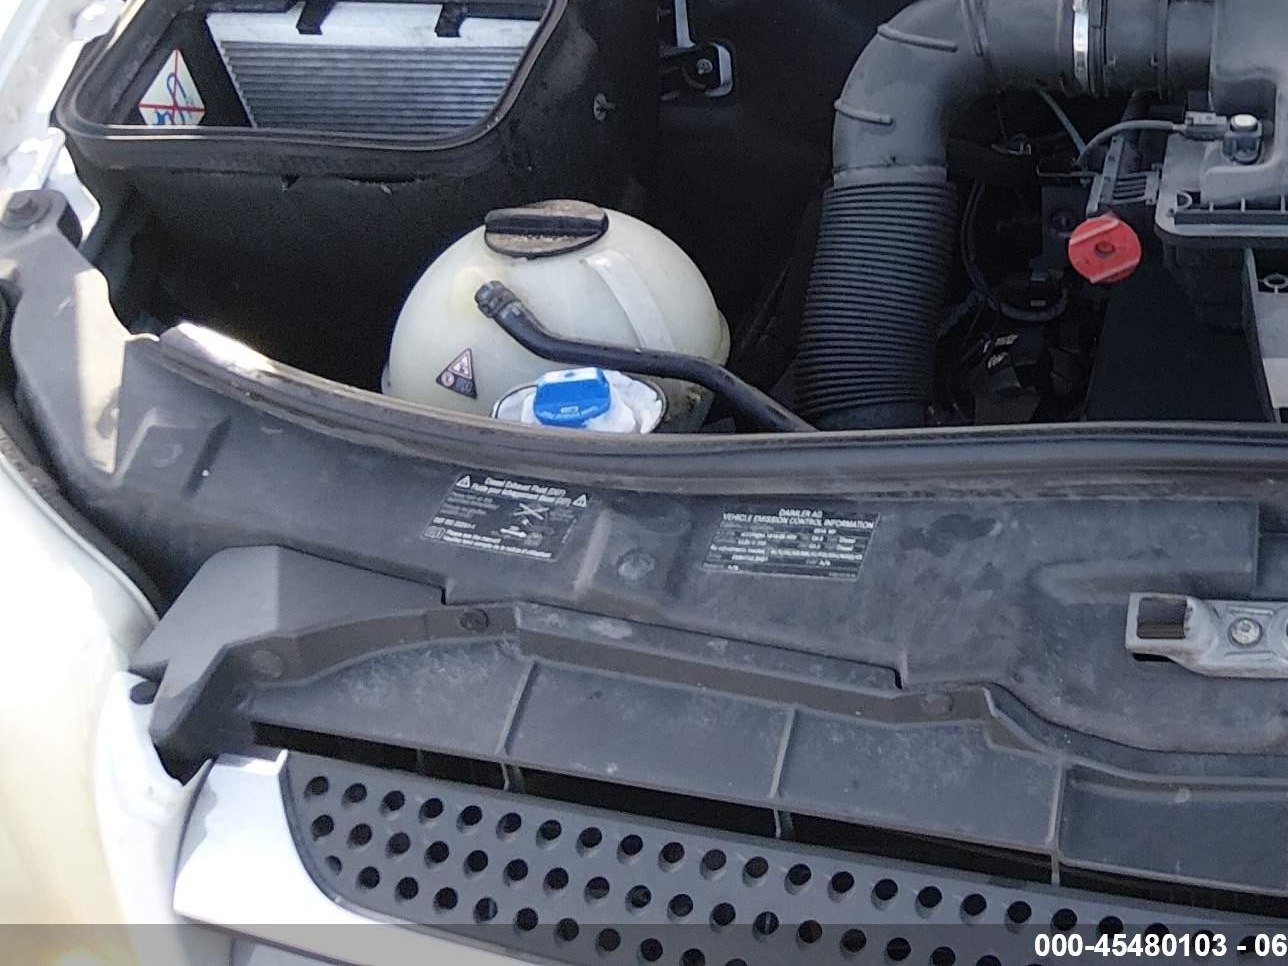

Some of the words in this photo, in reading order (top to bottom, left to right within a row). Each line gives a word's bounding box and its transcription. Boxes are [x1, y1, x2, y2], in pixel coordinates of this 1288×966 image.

[723, 512, 752, 523] VEHICLE
[753, 514, 789, 525] EMISSION
[788, 516, 823, 527] CONTROL
[823, 518, 874, 529] INFORMATION
